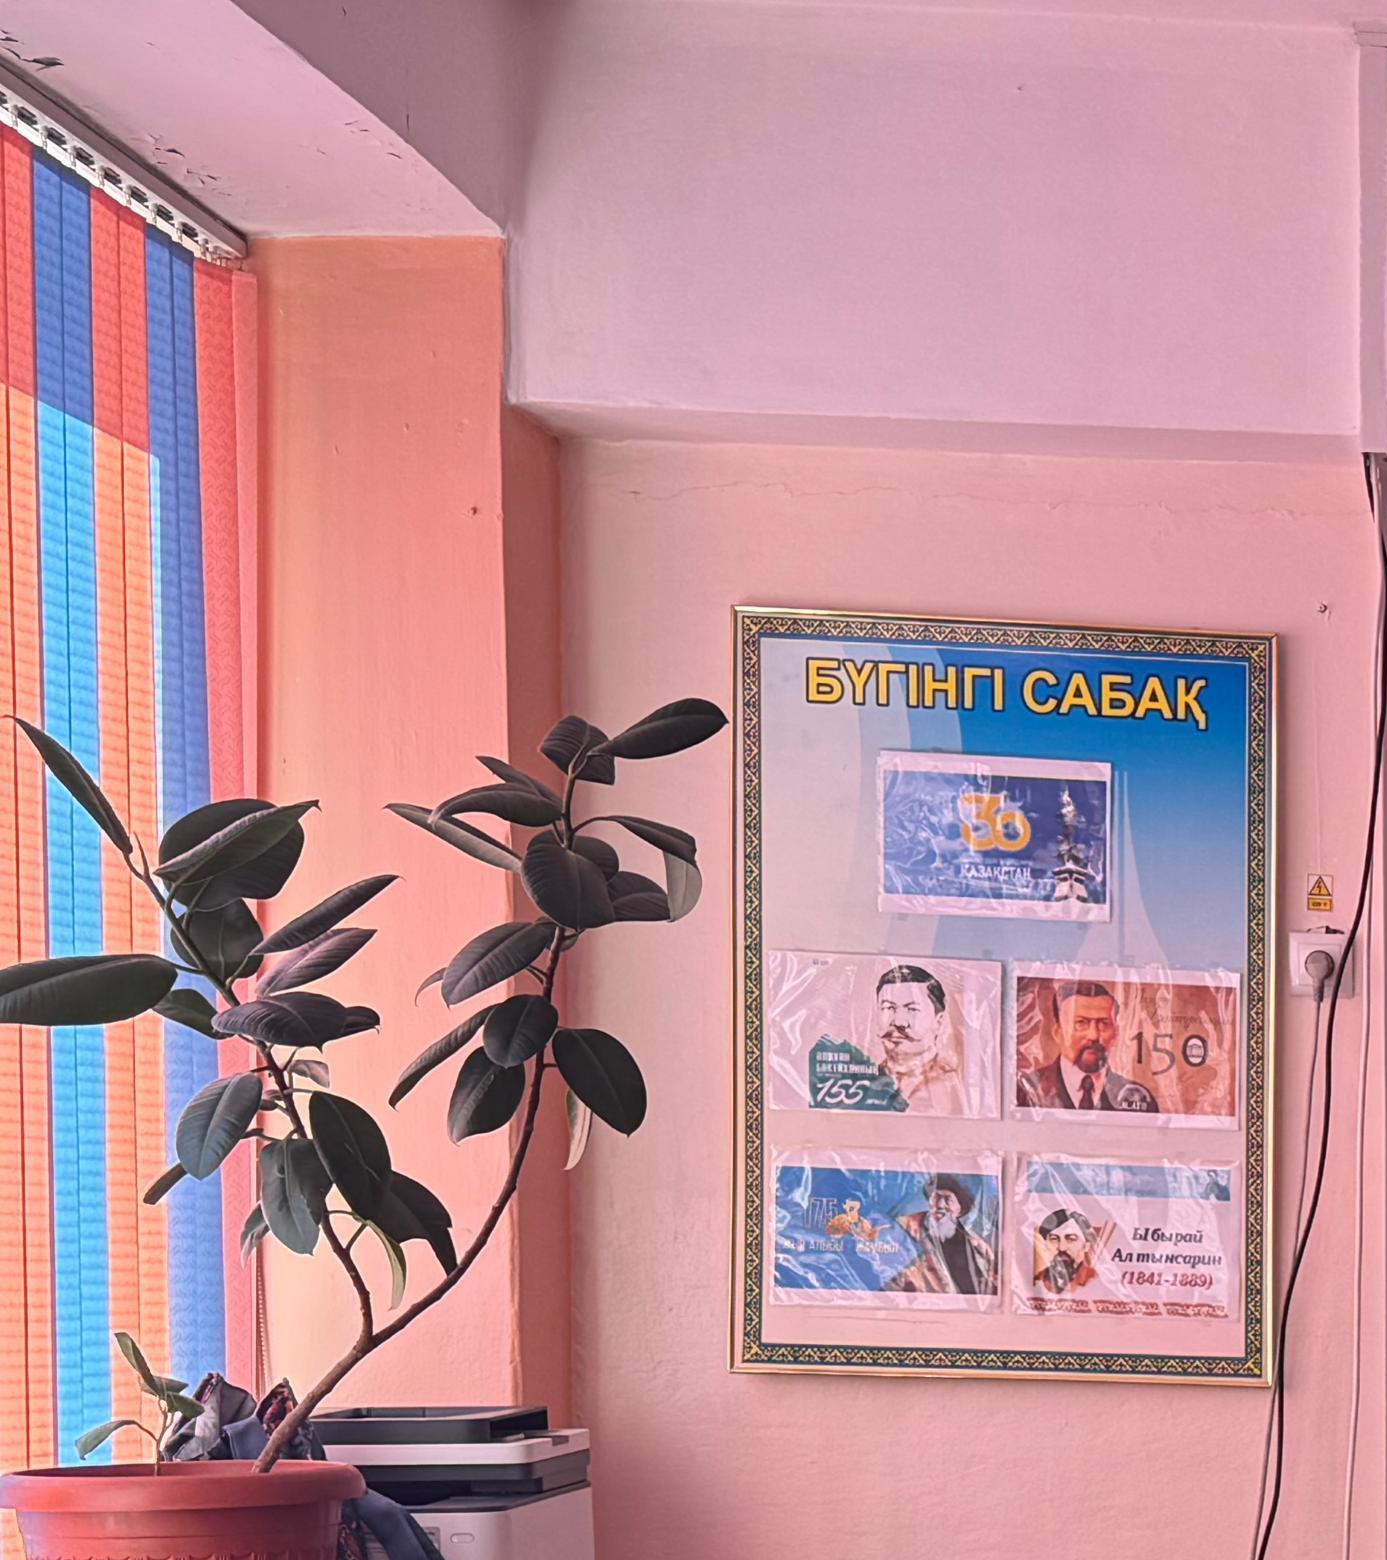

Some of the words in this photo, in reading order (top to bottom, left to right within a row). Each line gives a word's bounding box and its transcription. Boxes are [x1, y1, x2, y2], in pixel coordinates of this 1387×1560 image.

[805, 656, 1005, 712] БҮГІНГІ
[1021, 668, 1208, 731] САБАҚ
[960, 793, 1032, 852] 30
[1129, 1030, 1209, 1076] 150
[816, 1077, 871, 1105] 155
[1132, 1226, 1204, 1244] Ыбырай
[1111, 1247, 1223, 1269] Алтынсарин
[1120, 1270, 1214, 1290] (1841-1889)
